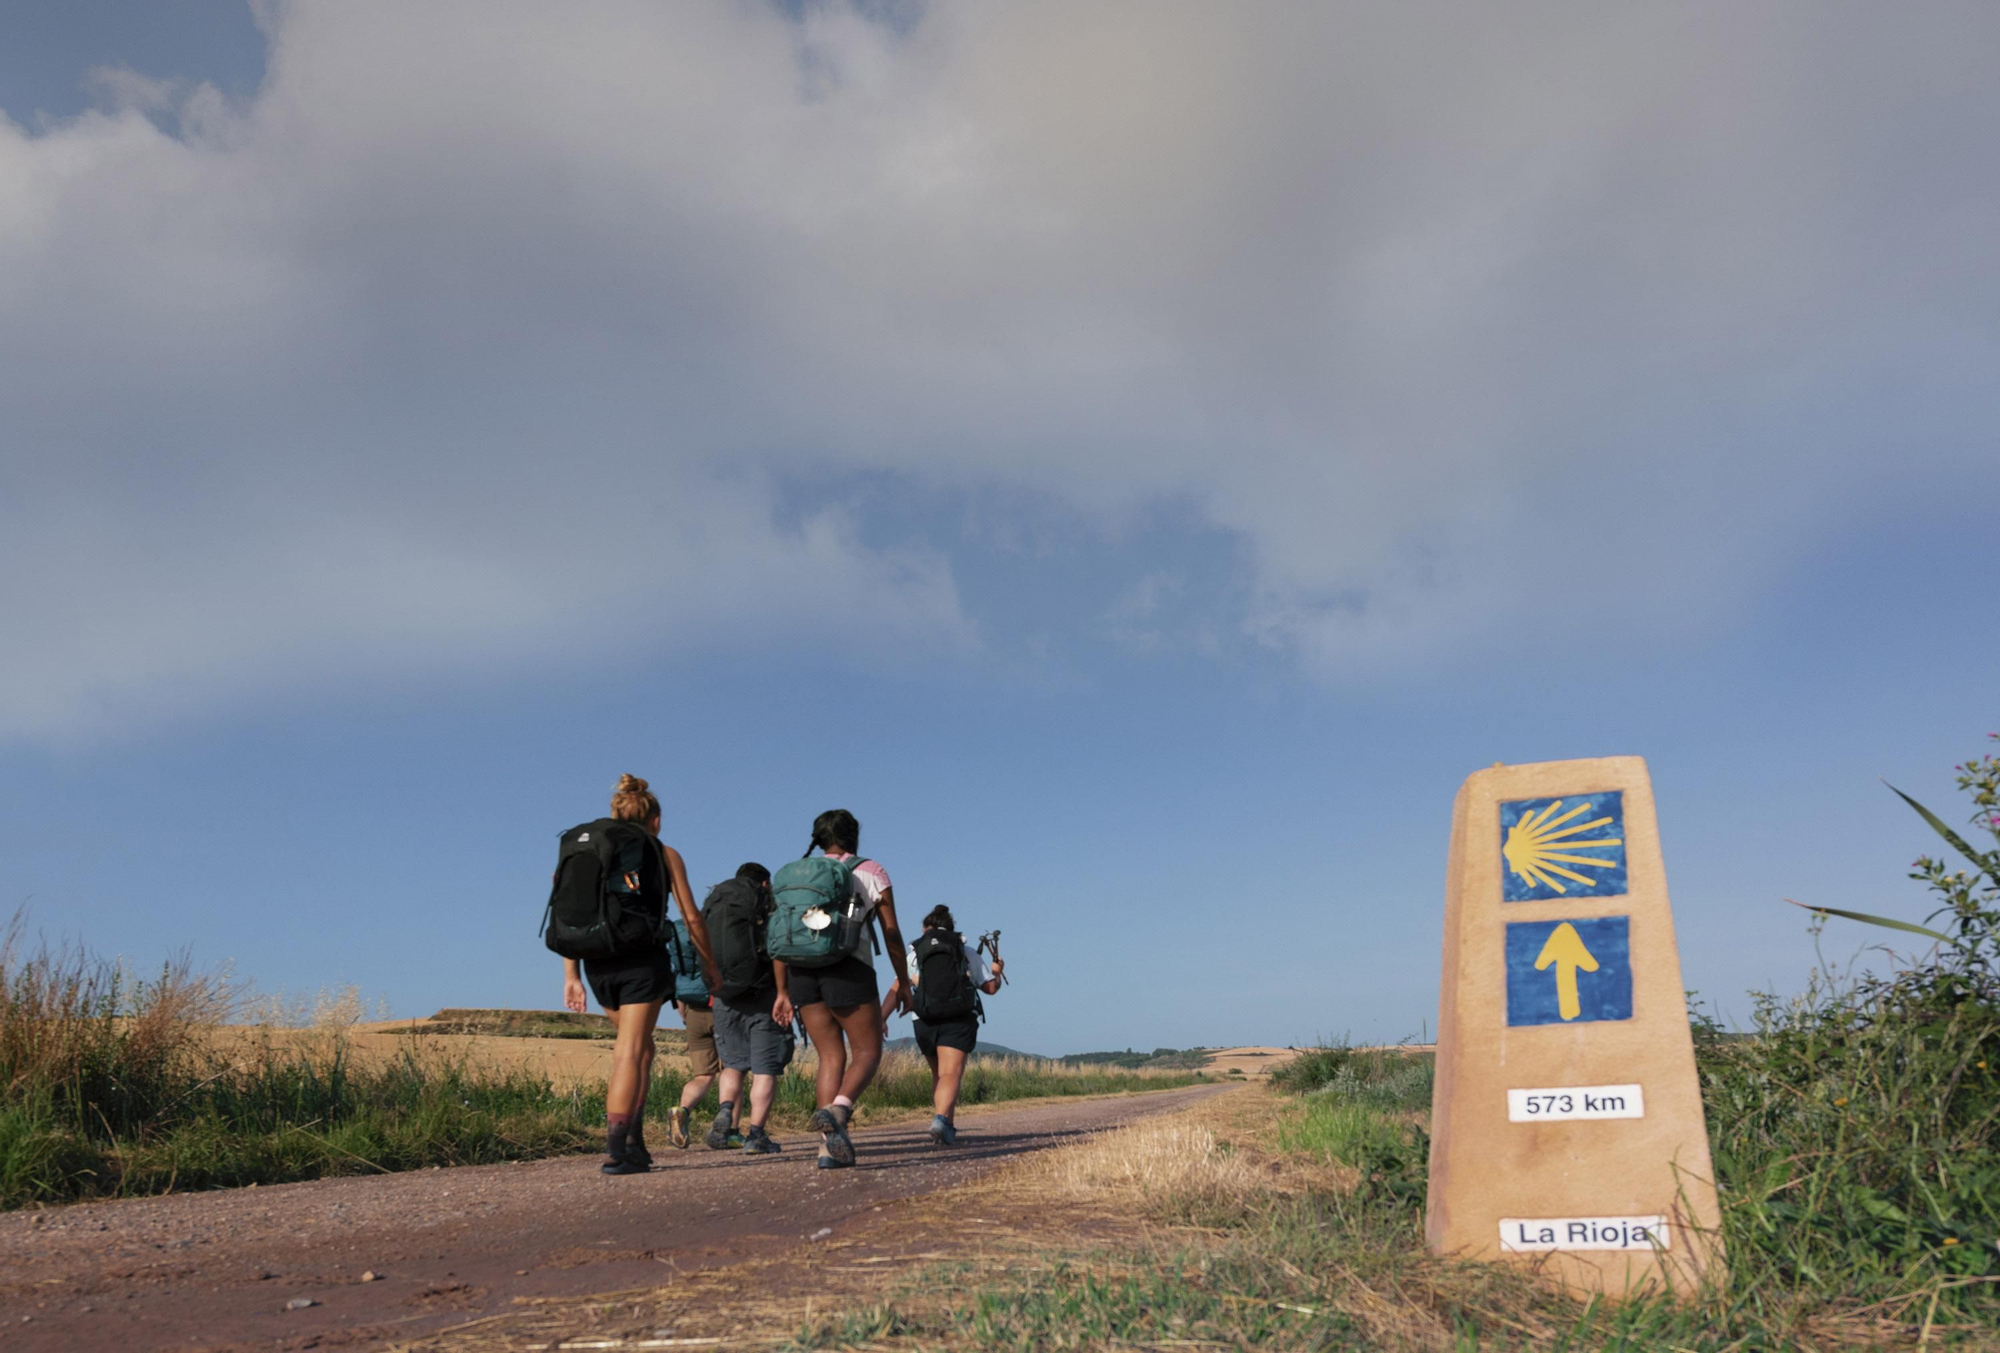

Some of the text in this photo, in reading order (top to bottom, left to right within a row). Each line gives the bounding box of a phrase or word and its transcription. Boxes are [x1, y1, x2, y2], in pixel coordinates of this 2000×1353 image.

[1526, 1094, 1625, 1114] 573 km
[1519, 1221, 1649, 1247] La Rioja
